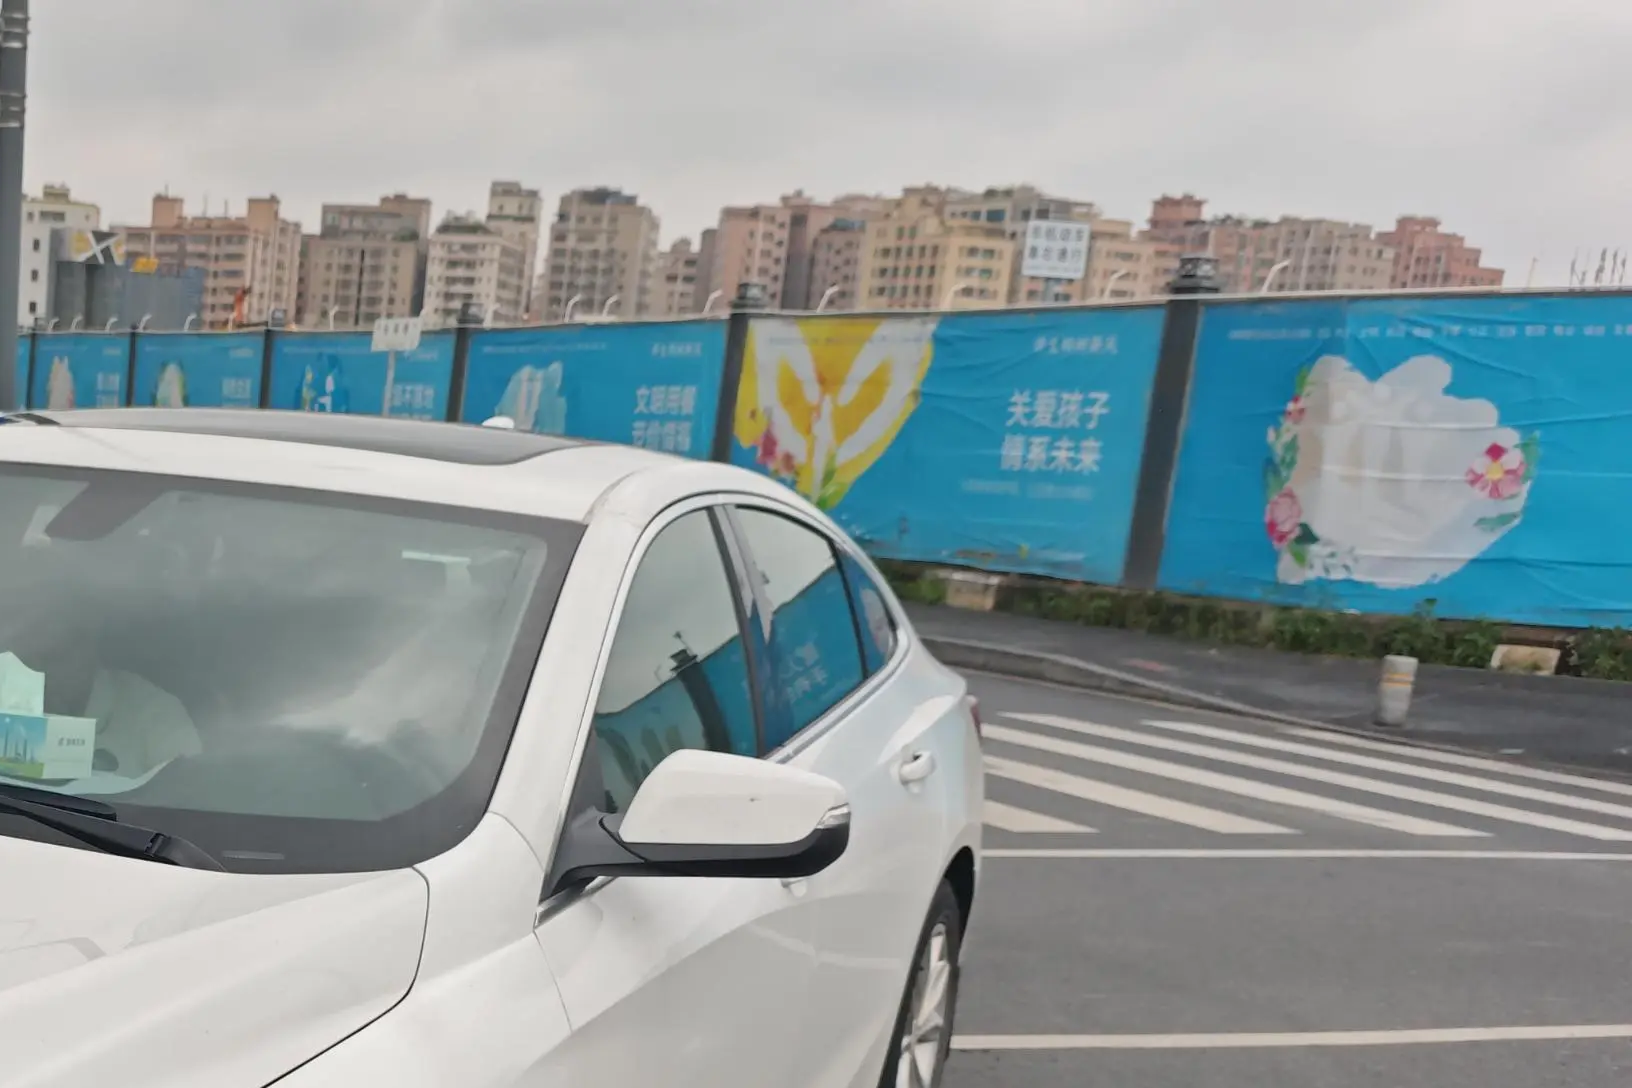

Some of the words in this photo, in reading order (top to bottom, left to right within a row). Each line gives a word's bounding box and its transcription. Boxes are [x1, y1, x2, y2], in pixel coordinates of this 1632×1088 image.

[1005, 389, 1111, 430] 关爱孩子
[999, 433, 1104, 477] 情系未来
